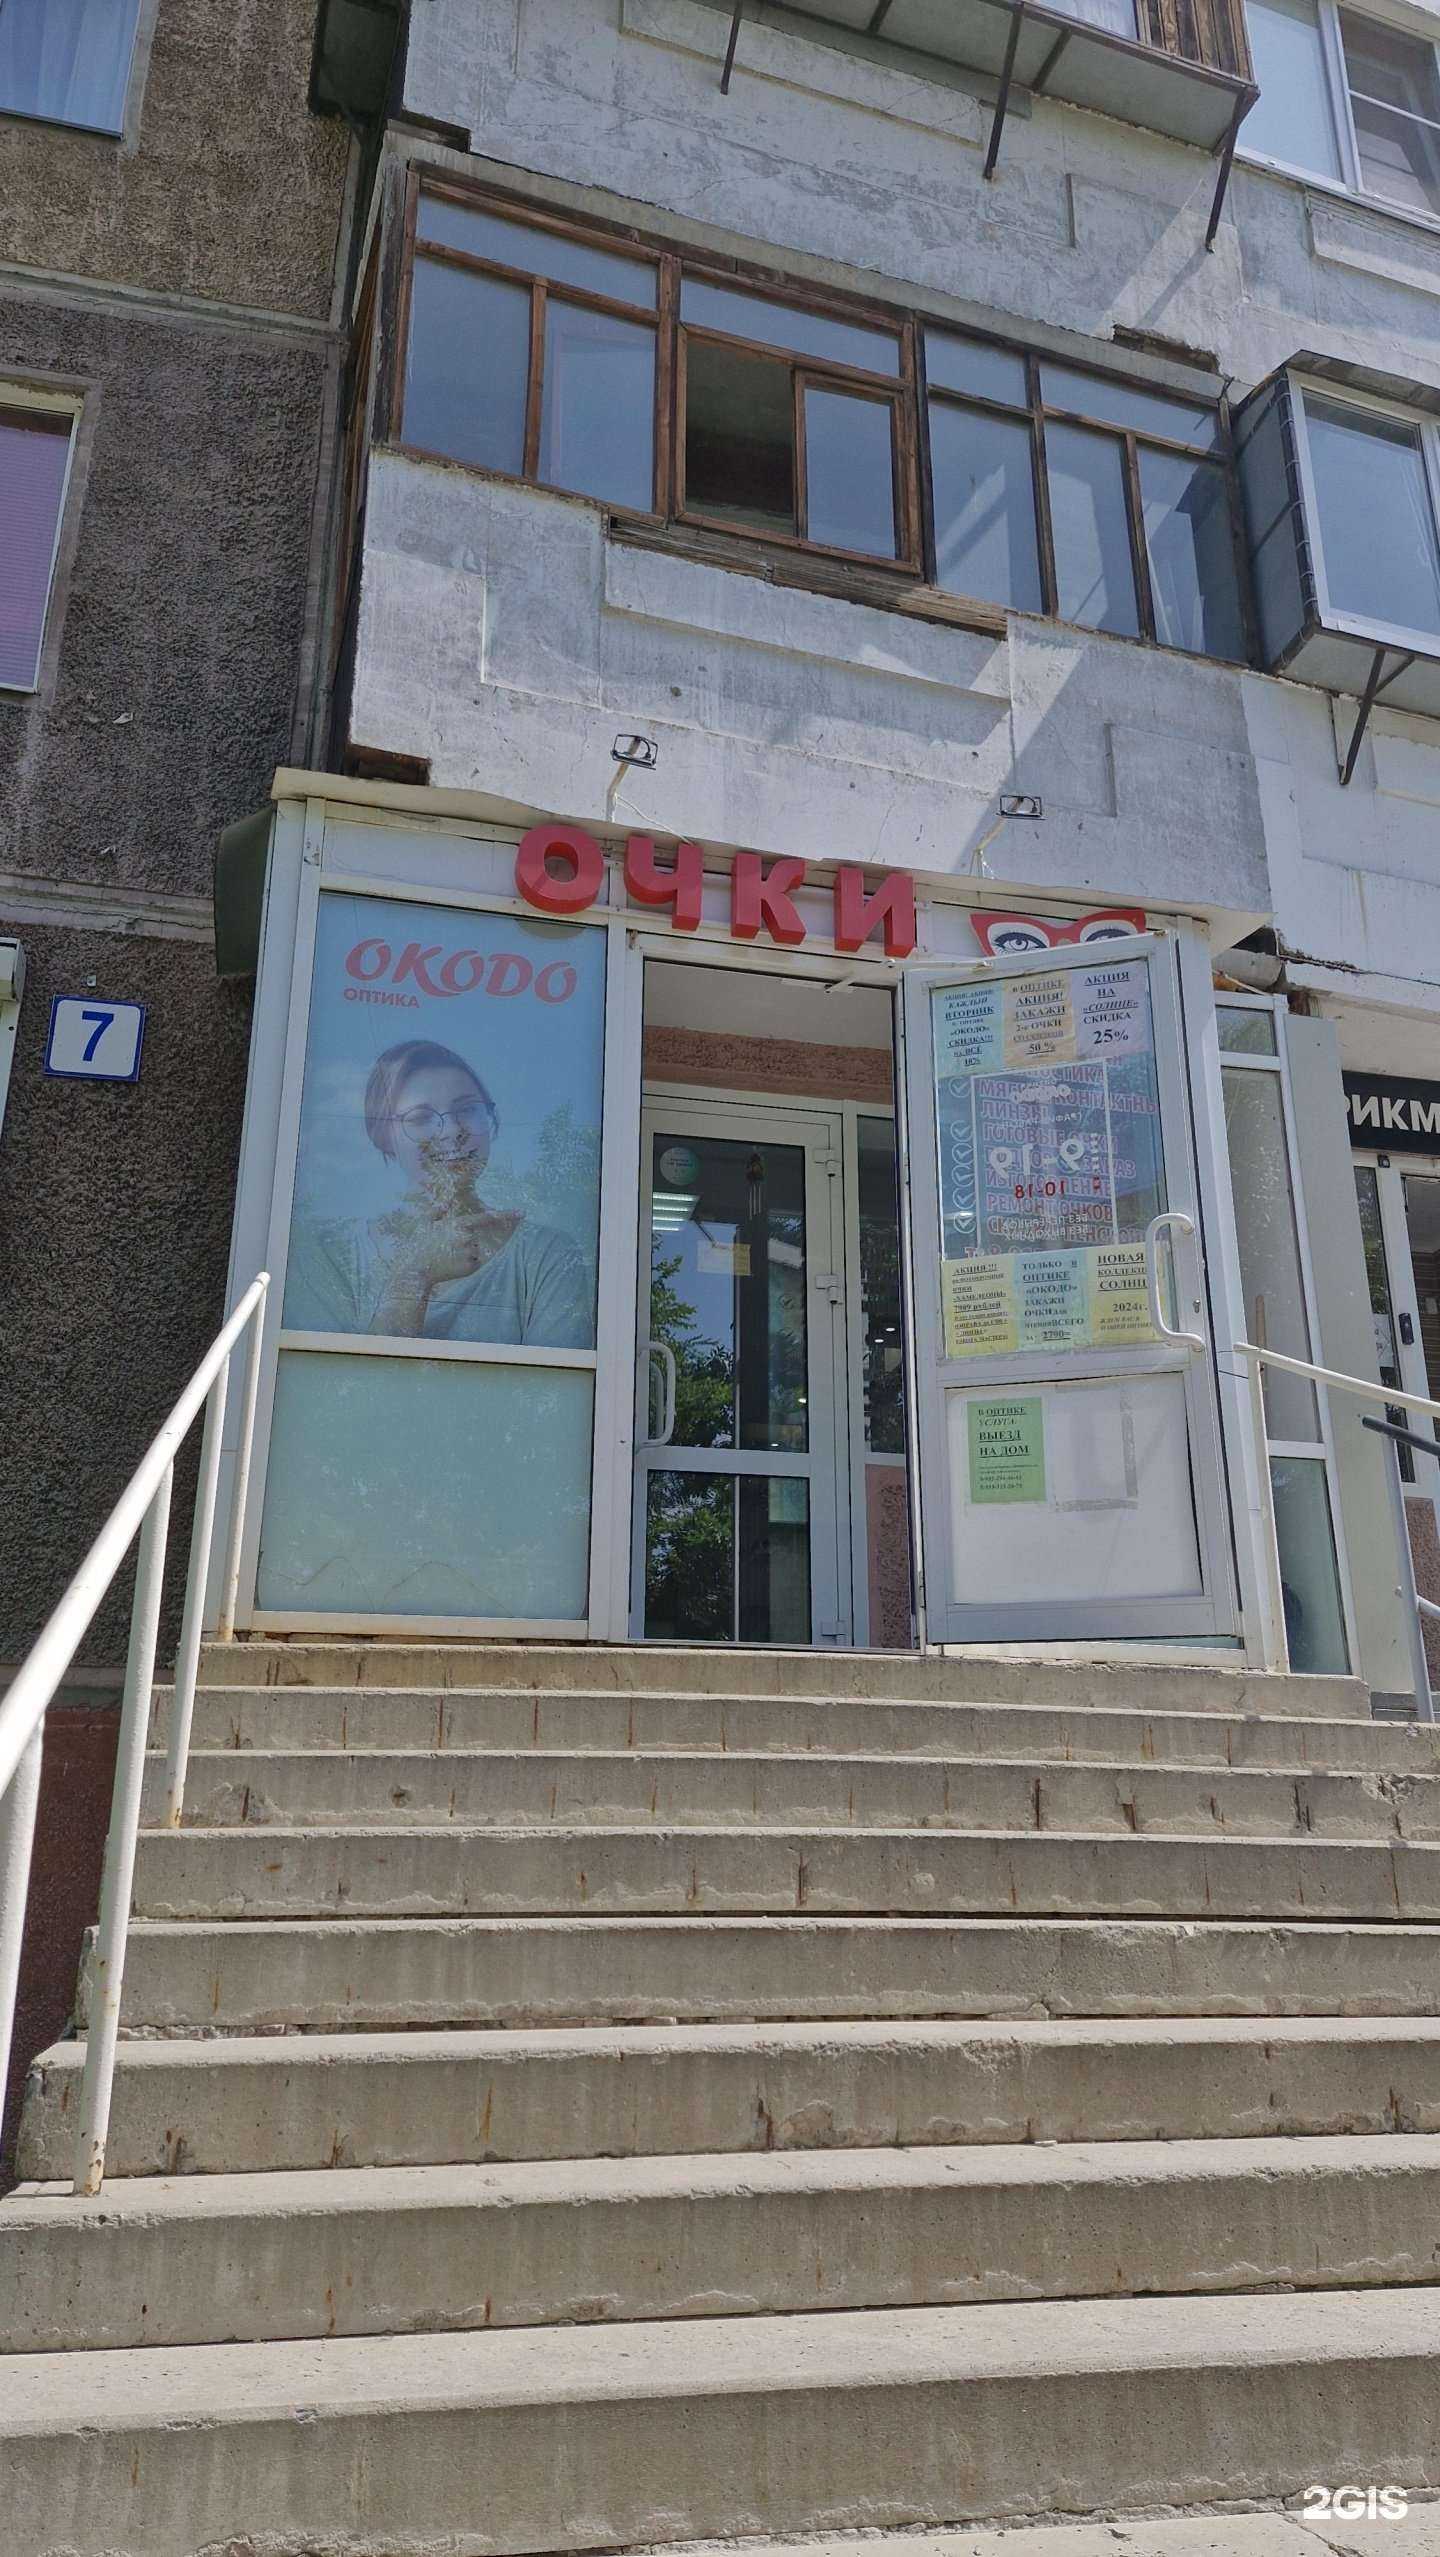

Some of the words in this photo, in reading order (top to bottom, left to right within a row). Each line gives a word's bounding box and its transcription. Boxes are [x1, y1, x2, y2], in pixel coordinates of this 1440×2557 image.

[515, 824, 916, 958] ОЧКИ
[1084, 971, 1129, 985] АКЦИЯ
[343, 988, 420, 1009] ОПТИКА
[1097, 988, 1116, 998] НА
[945, 1006, 994, 1020] ВТОРНИК
[1083, 1012, 1131, 1025] СКИДКА
[82, 1010, 114, 1061] 7
[1093, 1028, 1129, 1045] 25%
[1098, 1252, 1144, 1264] НОВАЯ
[1023, 1260, 1063, 1271] ТОЛЬКО
[1022, 1271, 1071, 1282] ОПТИКЕ
[1099, 1279, 1148, 1290] СОЛНЦ
[986, 1407, 1025, 1417] ОПТИКЕ
[979, 1429, 1021, 1441] ВЫЕЗД
[979, 1447, 997, 1457] НА
[1001, 1445, 1029, 1456] ДОМ
